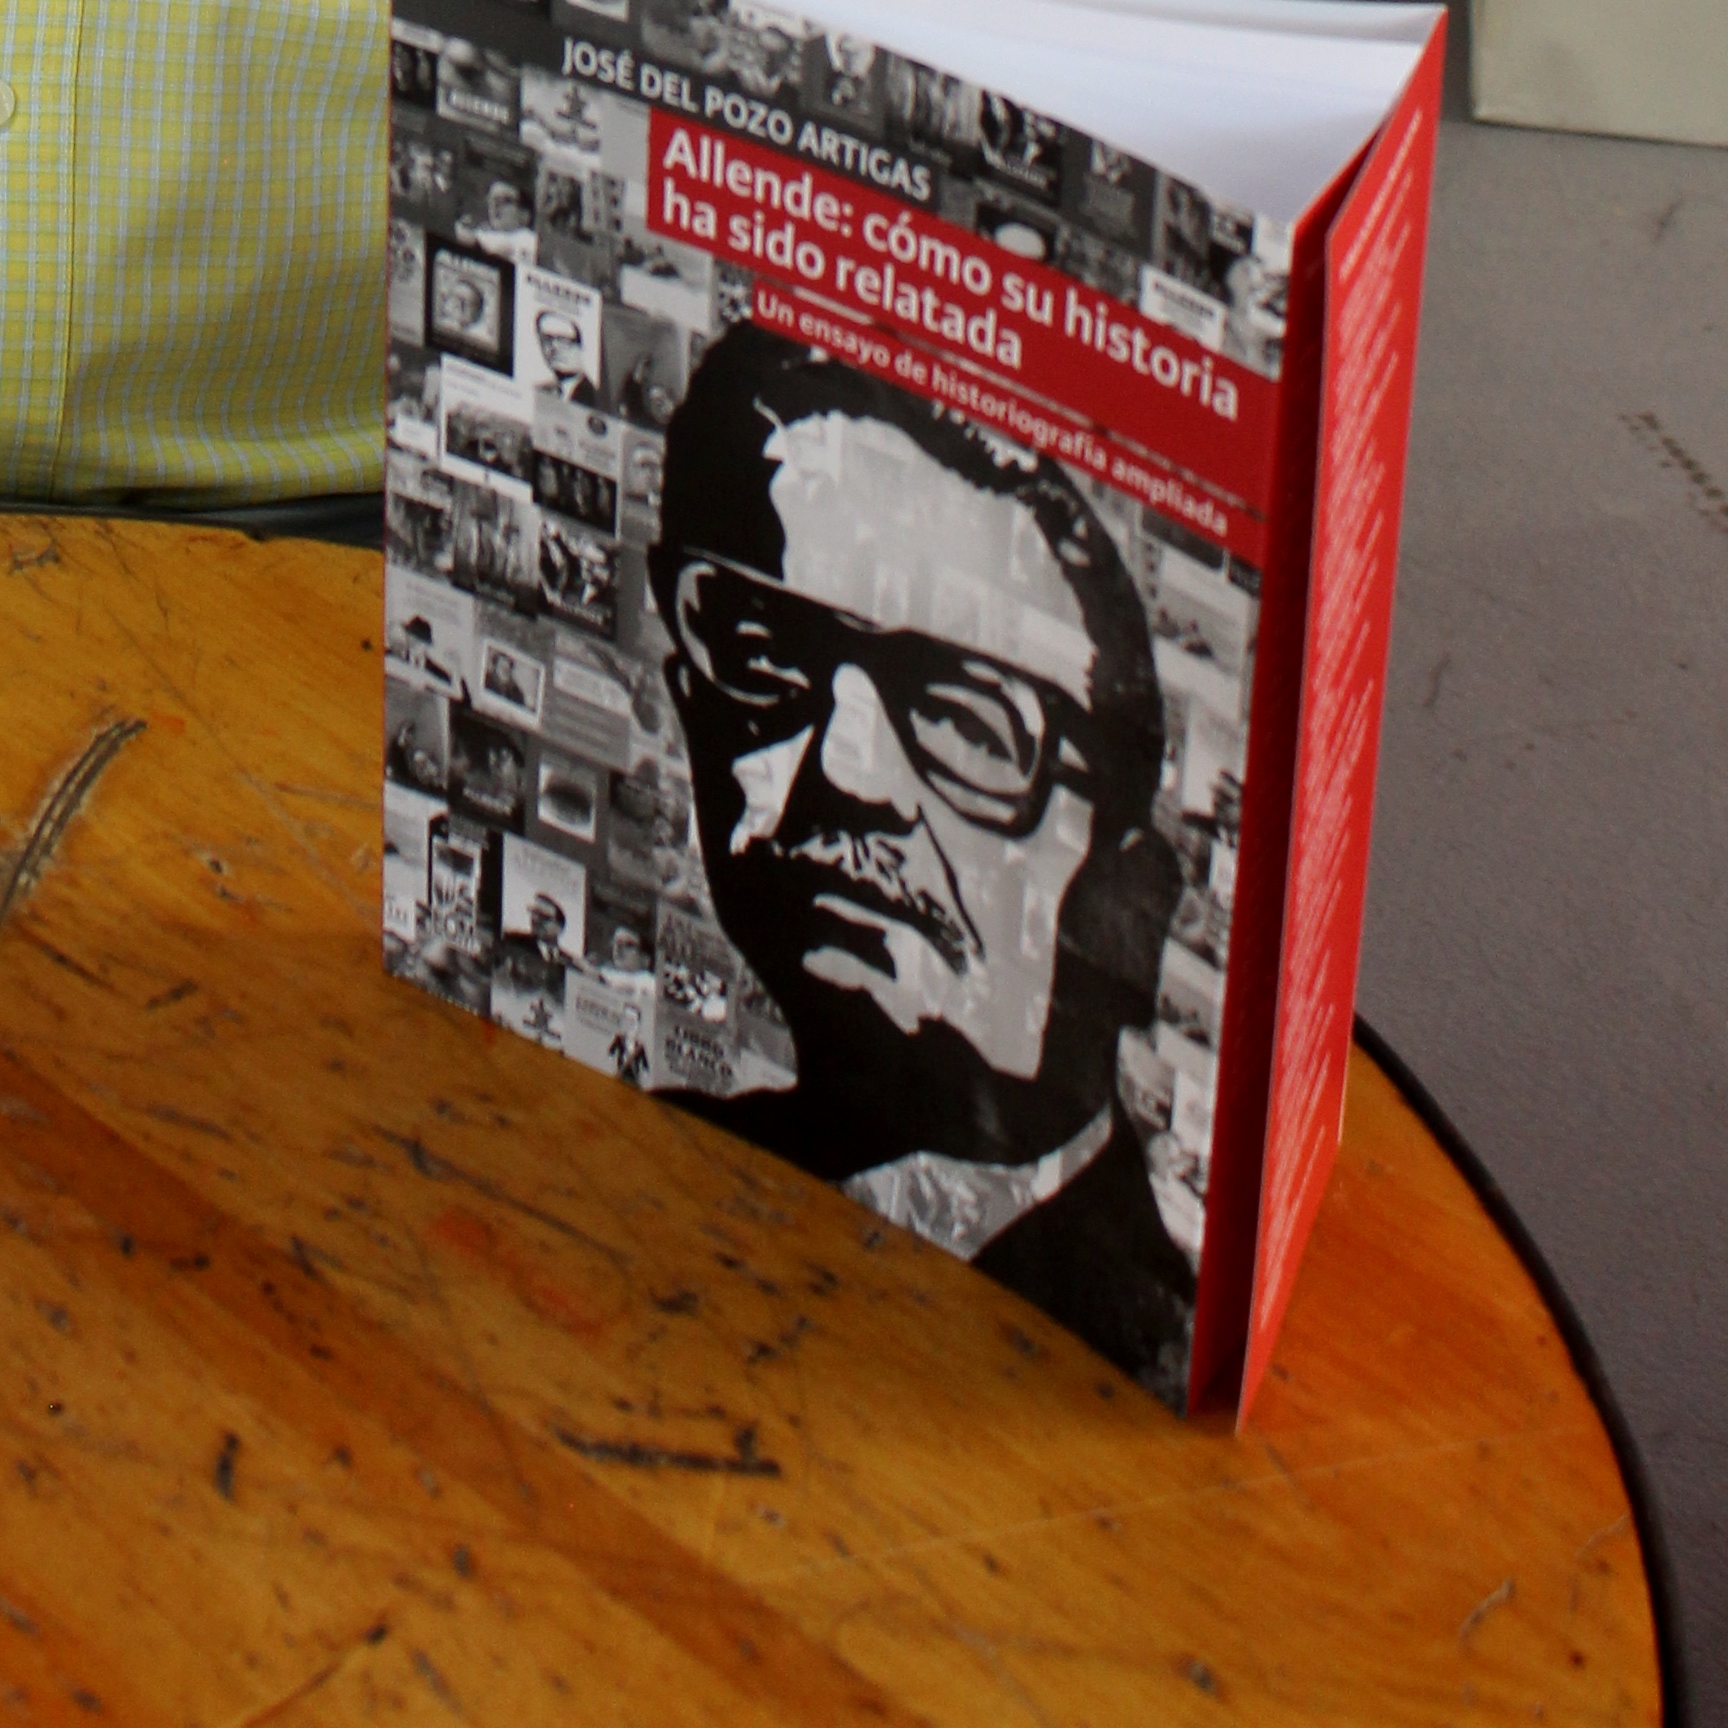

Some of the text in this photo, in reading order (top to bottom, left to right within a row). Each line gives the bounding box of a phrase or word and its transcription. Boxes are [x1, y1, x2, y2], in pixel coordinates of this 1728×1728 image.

[562, 36, 636, 91] JOSÉ
[639, 61, 700, 113] DEL
[704, 85, 794, 145] POZO
[797, 120, 932, 201] ARTIGAS
[662, 175, 1023, 371] ha sido relatada
[662, 127, 1240, 421] Allende: cómo su historia
[756, 289, 1228, 537] Un ensayo de historiografía ampliada
